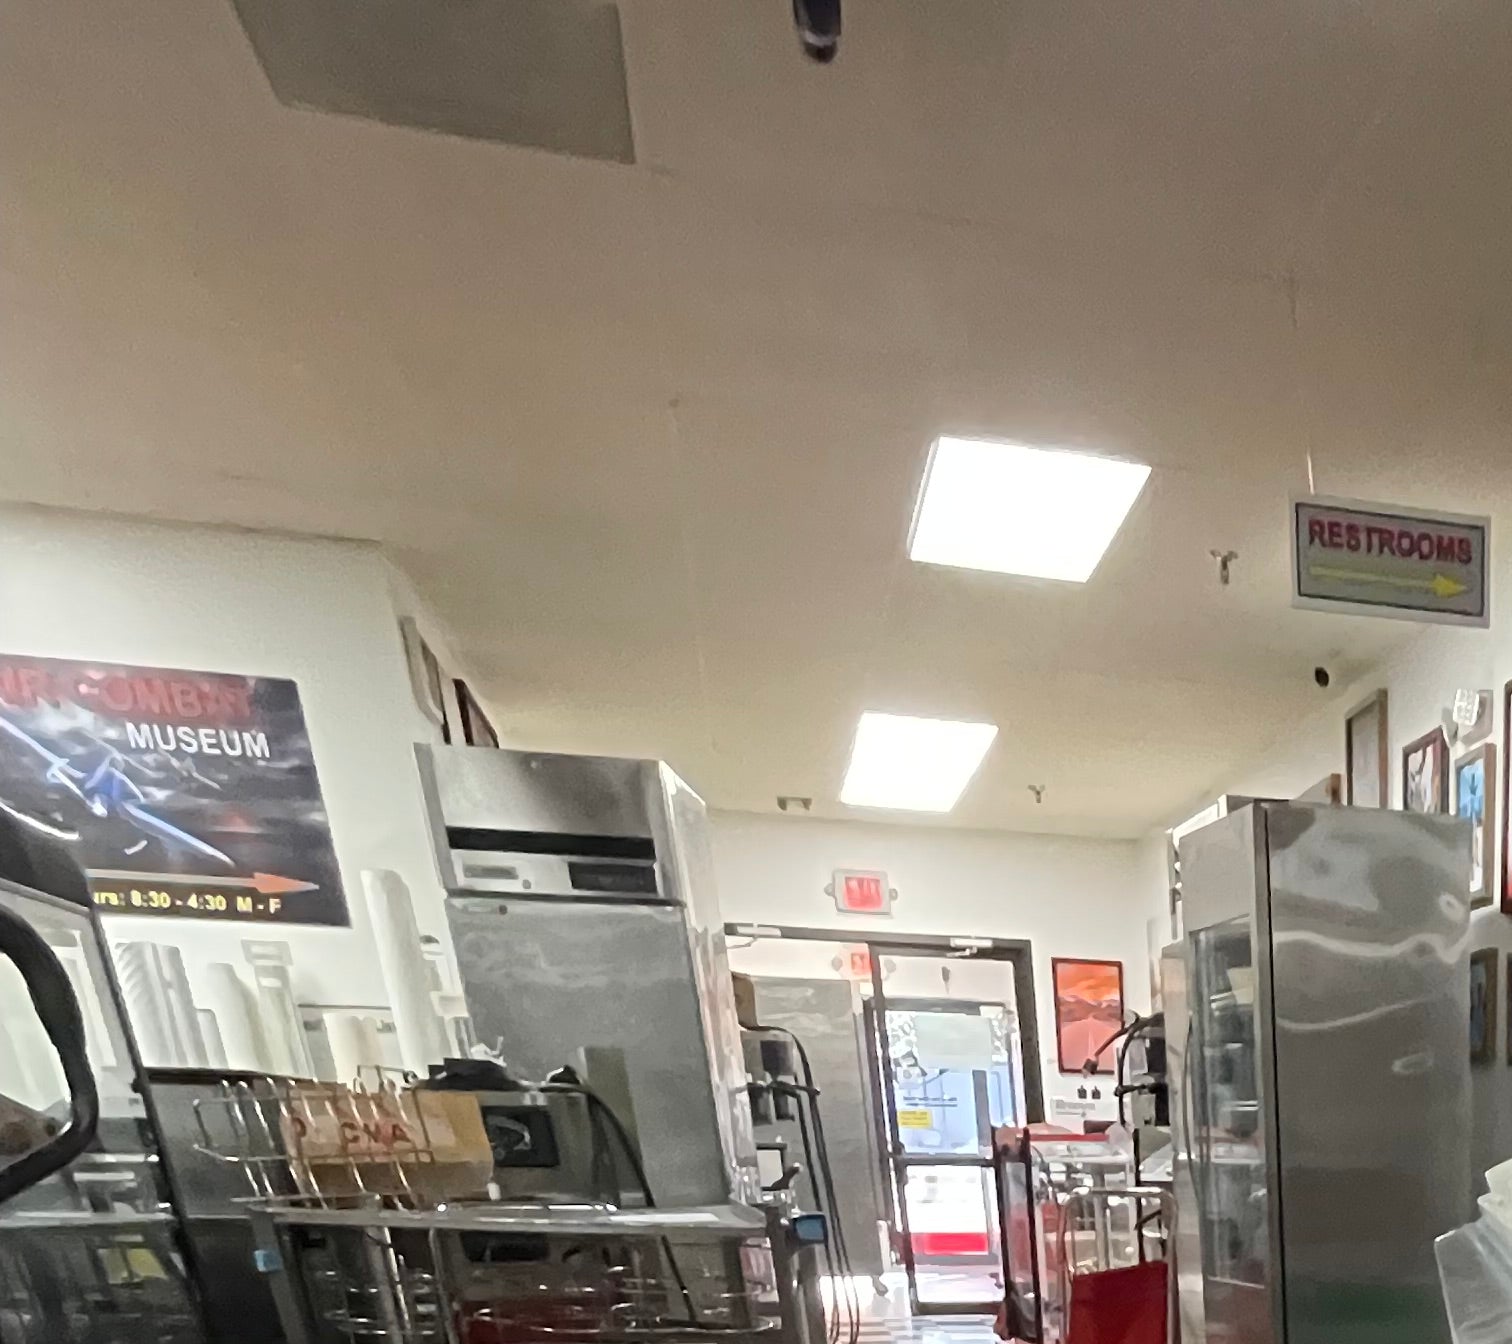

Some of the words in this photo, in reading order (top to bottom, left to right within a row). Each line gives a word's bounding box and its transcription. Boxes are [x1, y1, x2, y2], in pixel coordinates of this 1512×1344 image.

[1307, 518, 1473, 565] RESTROOMS
[126, 721, 271, 759] MUSEUM
[268, 897, 282, 915] F
